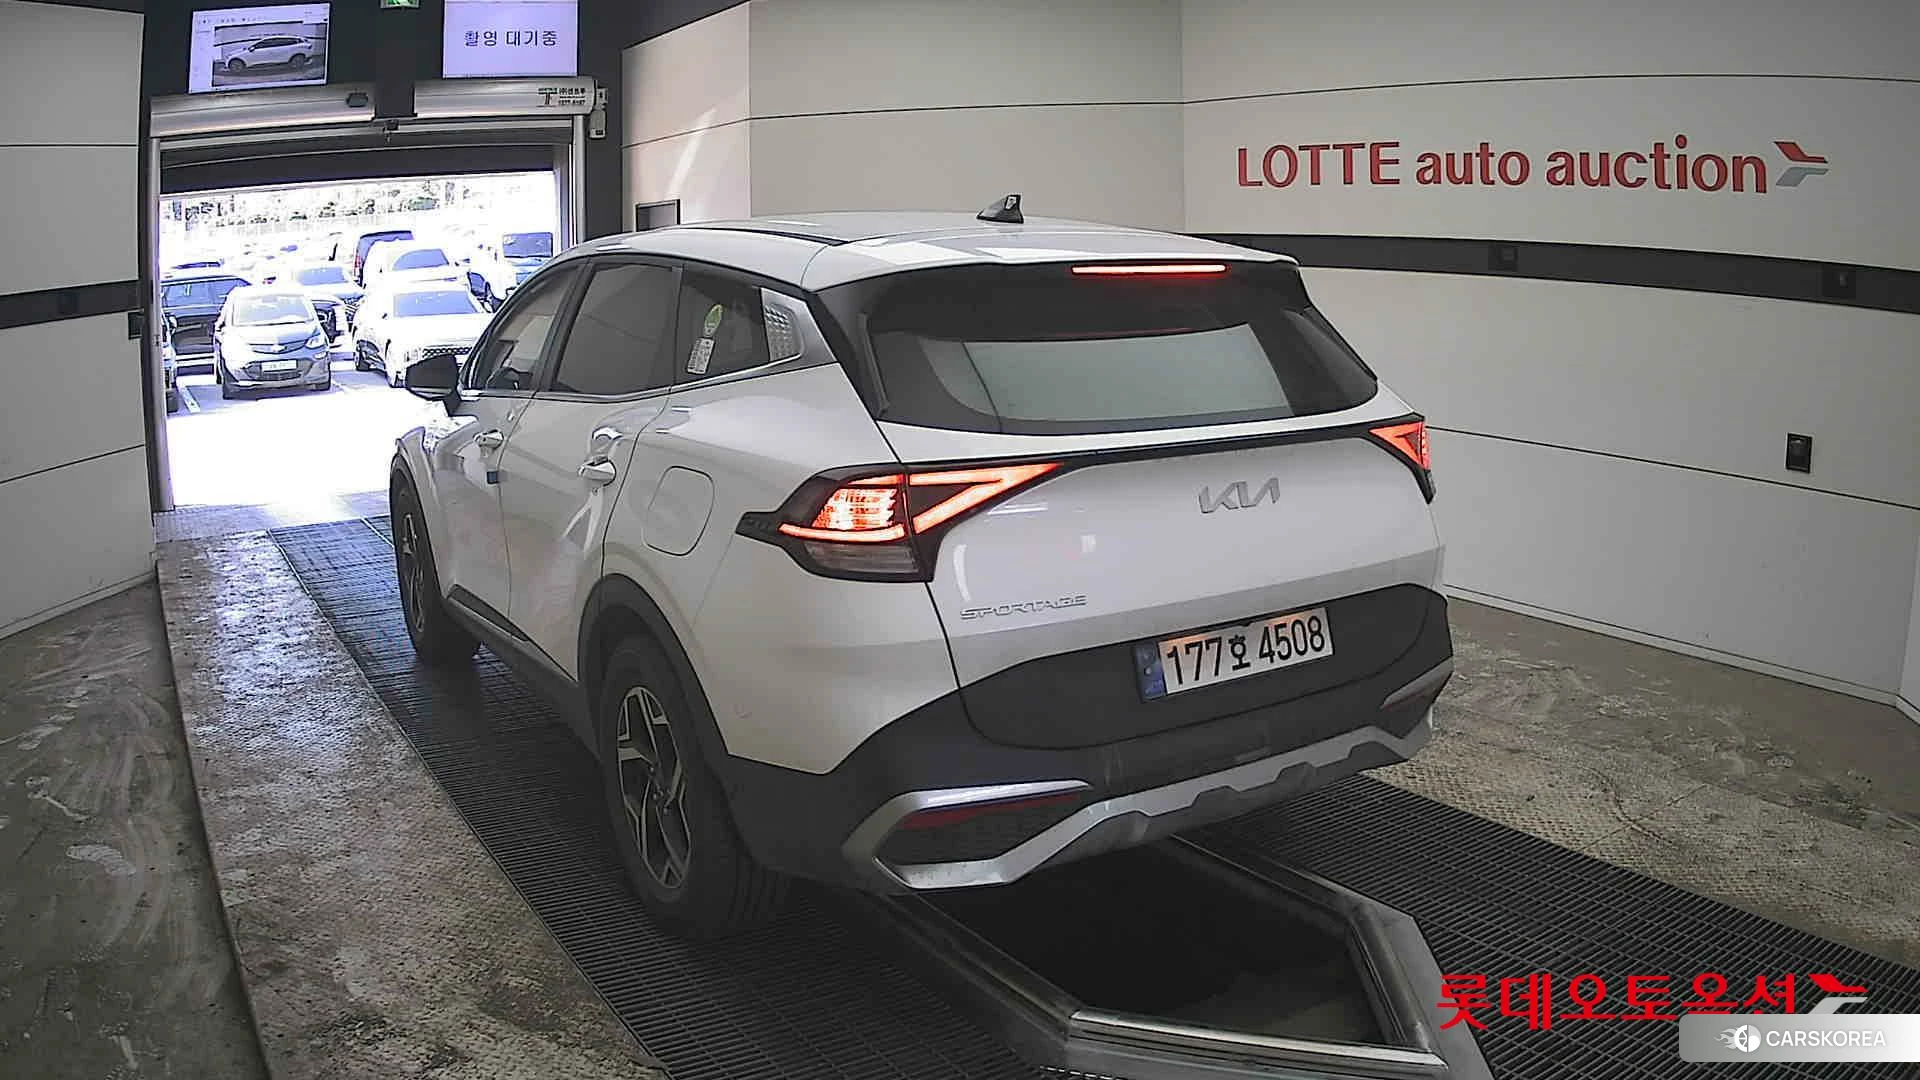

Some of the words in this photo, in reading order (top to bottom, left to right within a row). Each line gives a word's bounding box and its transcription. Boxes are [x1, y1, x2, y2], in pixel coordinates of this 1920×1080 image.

[464, 30, 498, 47] 촬영
[506, 30, 558, 47] 대기중
[1237, 141, 1401, 188] LOTTE
[1415, 141, 1531, 186] auto
[1545, 134, 1768, 194] auction
[1198, 477, 1281, 514] KIA
[959, 594, 1088, 620] SPORTAGE
[1166, 634, 1252, 686] 177호
[1258, 615, 1326, 665] 4508
